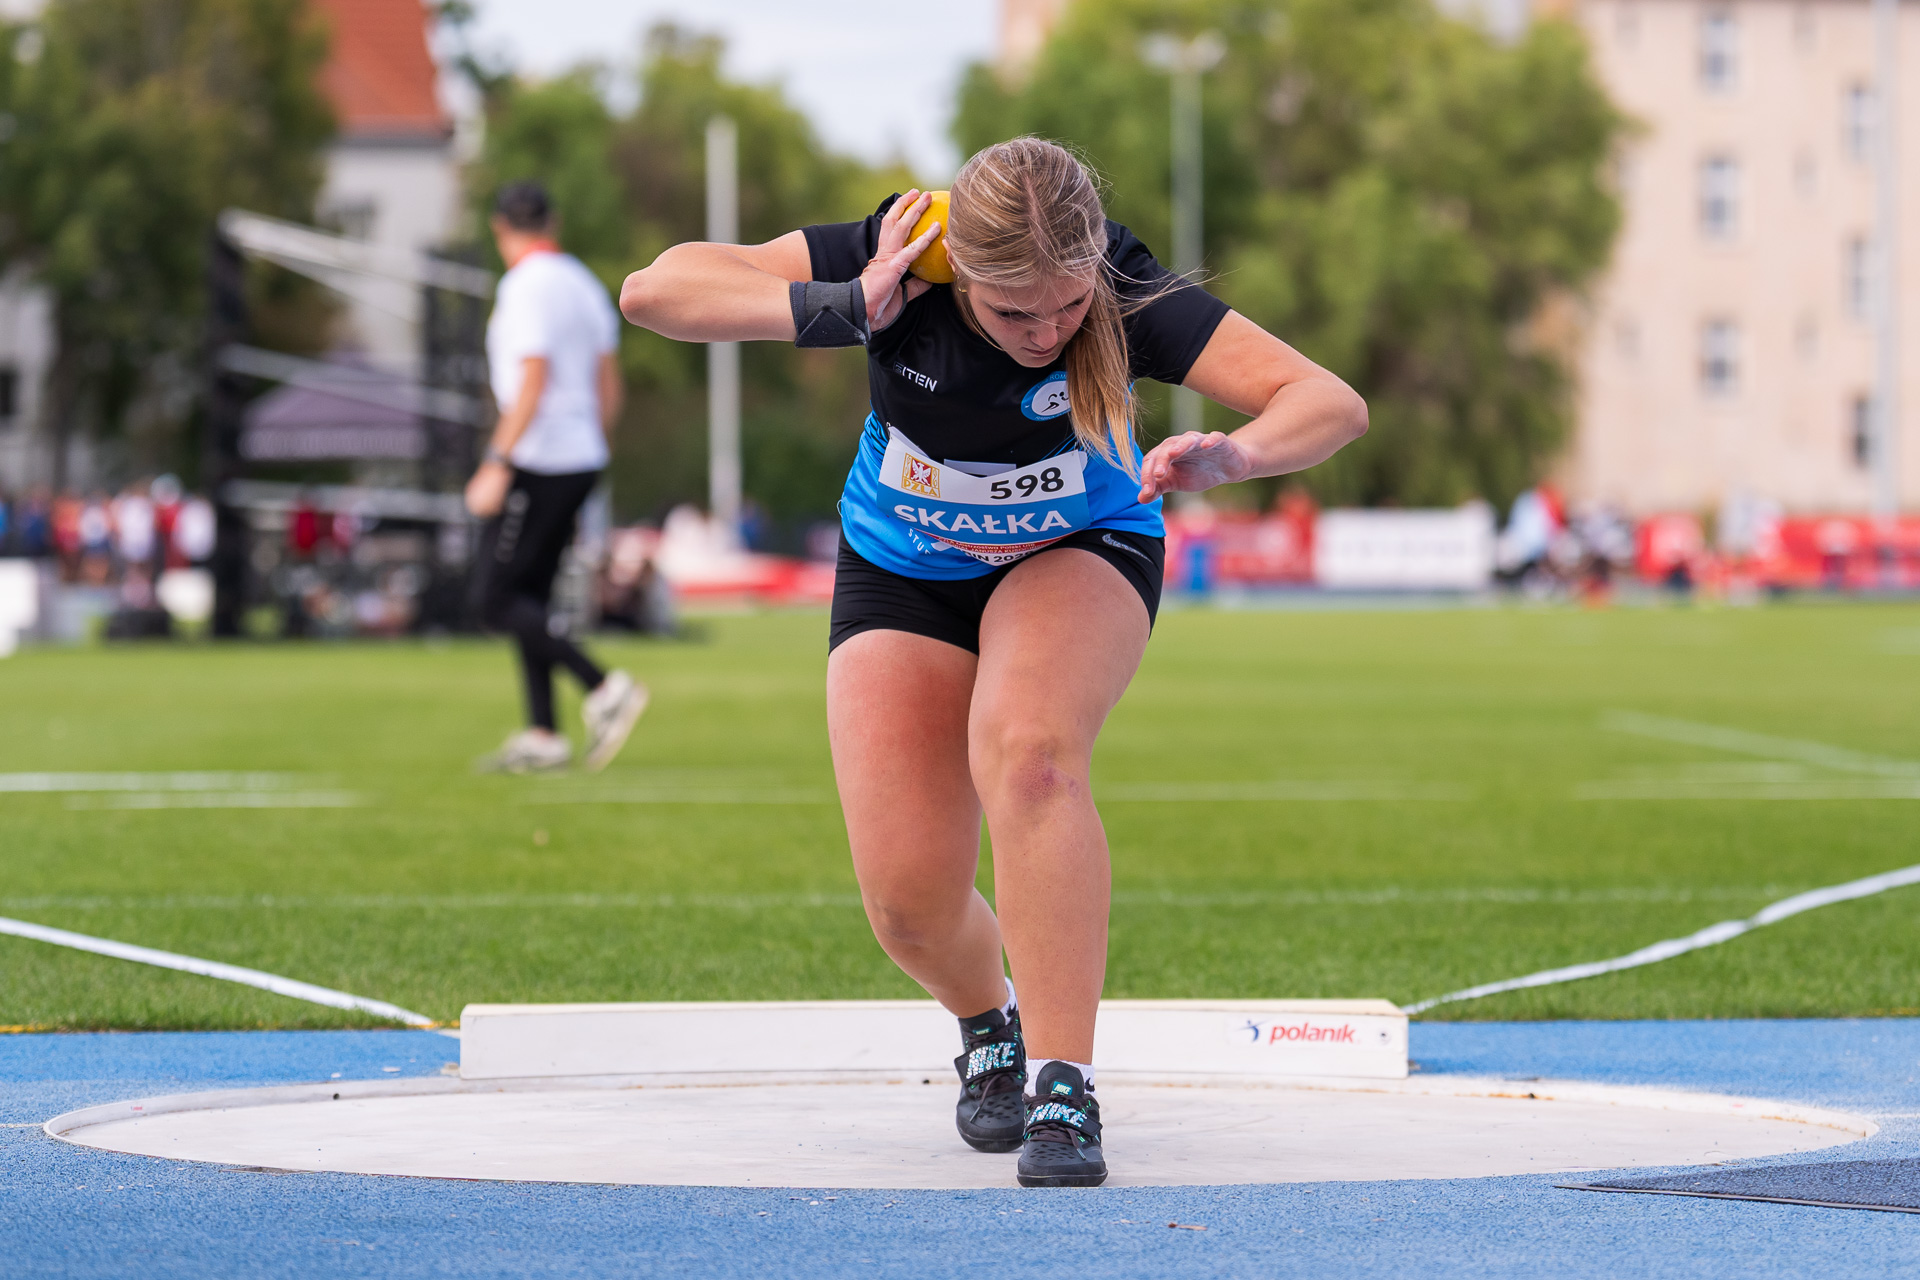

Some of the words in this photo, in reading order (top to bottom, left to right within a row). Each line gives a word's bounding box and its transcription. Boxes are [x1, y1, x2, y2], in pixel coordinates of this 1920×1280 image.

[903, 478, 938, 497] PZLA
[990, 467, 1064, 499] 598
[894, 505, 1072, 534] SKAŁKA
[1269, 1022, 1356, 1045] polanik
[965, 1042, 1017, 1080] NIKE
[1054, 1083, 1071, 1095] NIKE
[1026, 1102, 1088, 1128] NIKE
